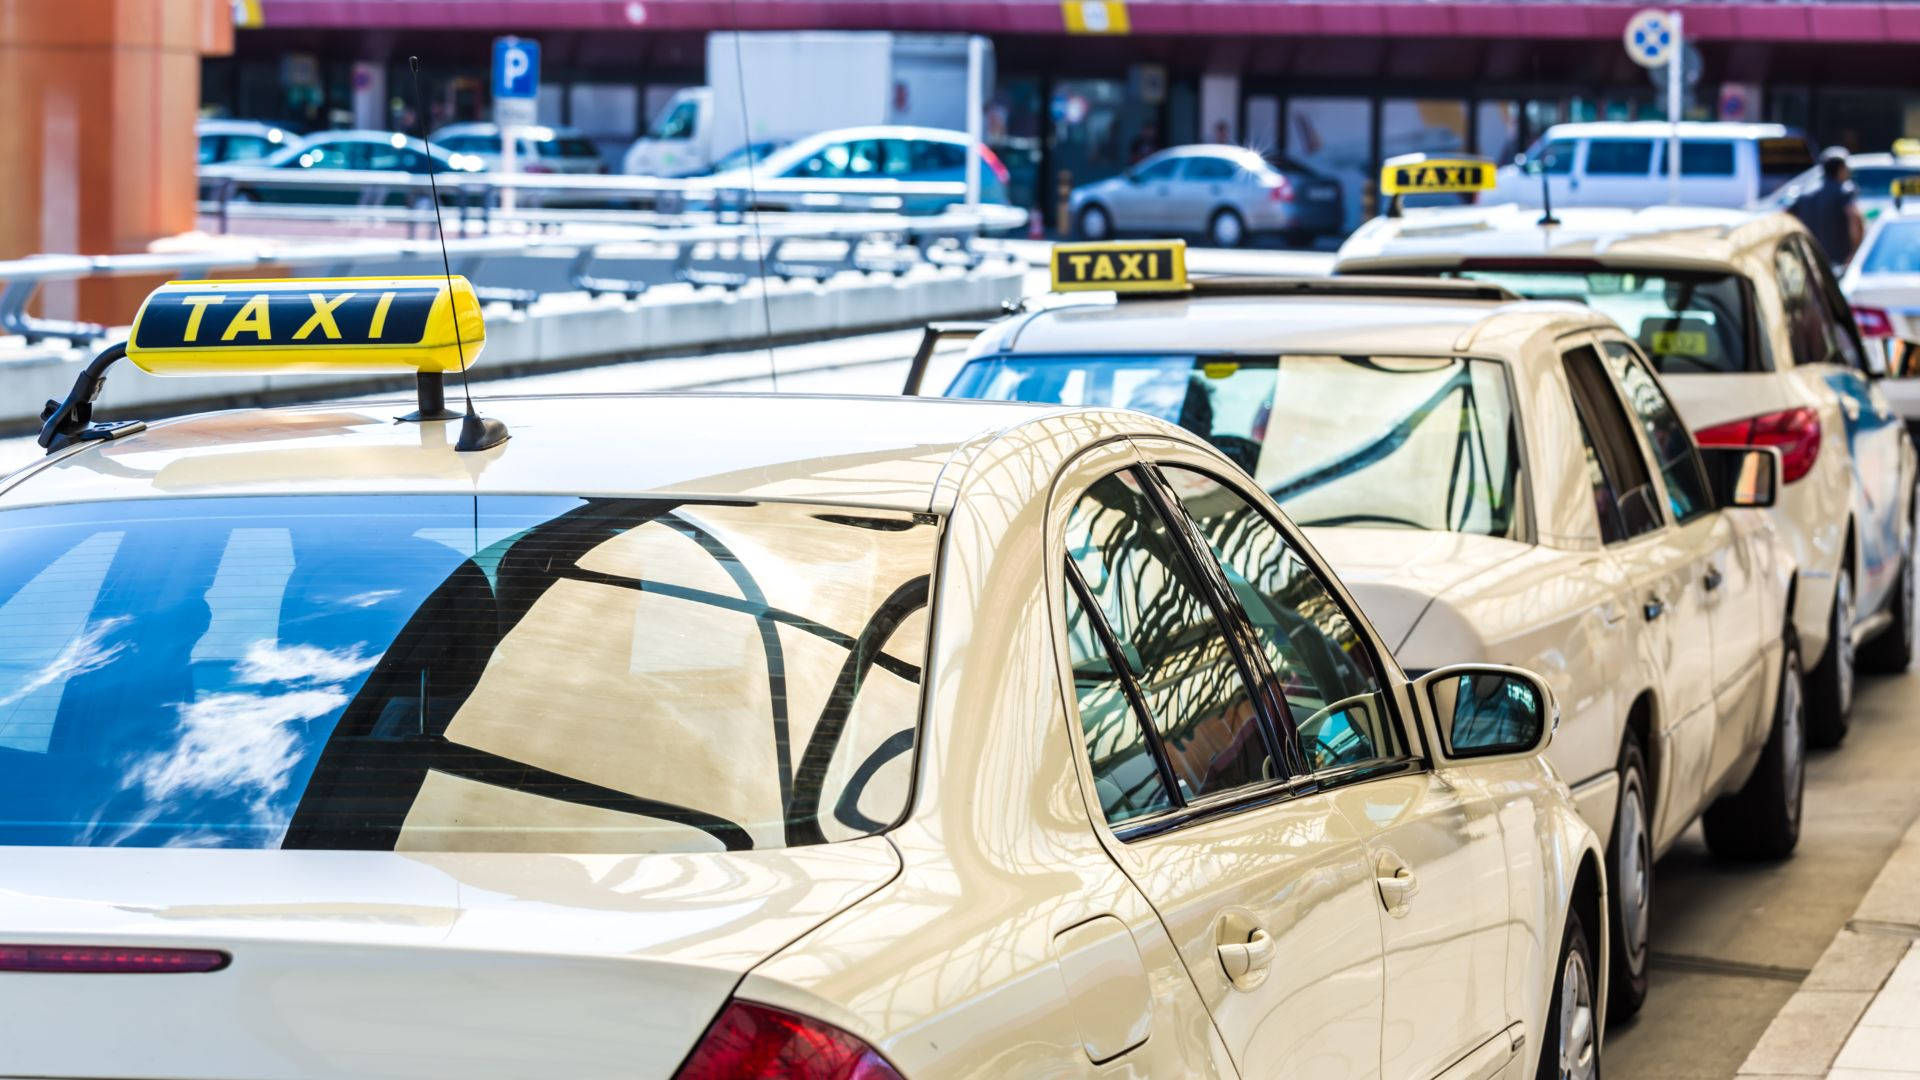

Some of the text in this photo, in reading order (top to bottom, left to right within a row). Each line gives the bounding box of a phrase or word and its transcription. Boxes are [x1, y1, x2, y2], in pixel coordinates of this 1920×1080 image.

[504, 48, 528, 88] P
[1403, 167, 1472, 187] TAXI
[1068, 253, 1158, 280] TAXI
[181, 292, 397, 342] TAXI
